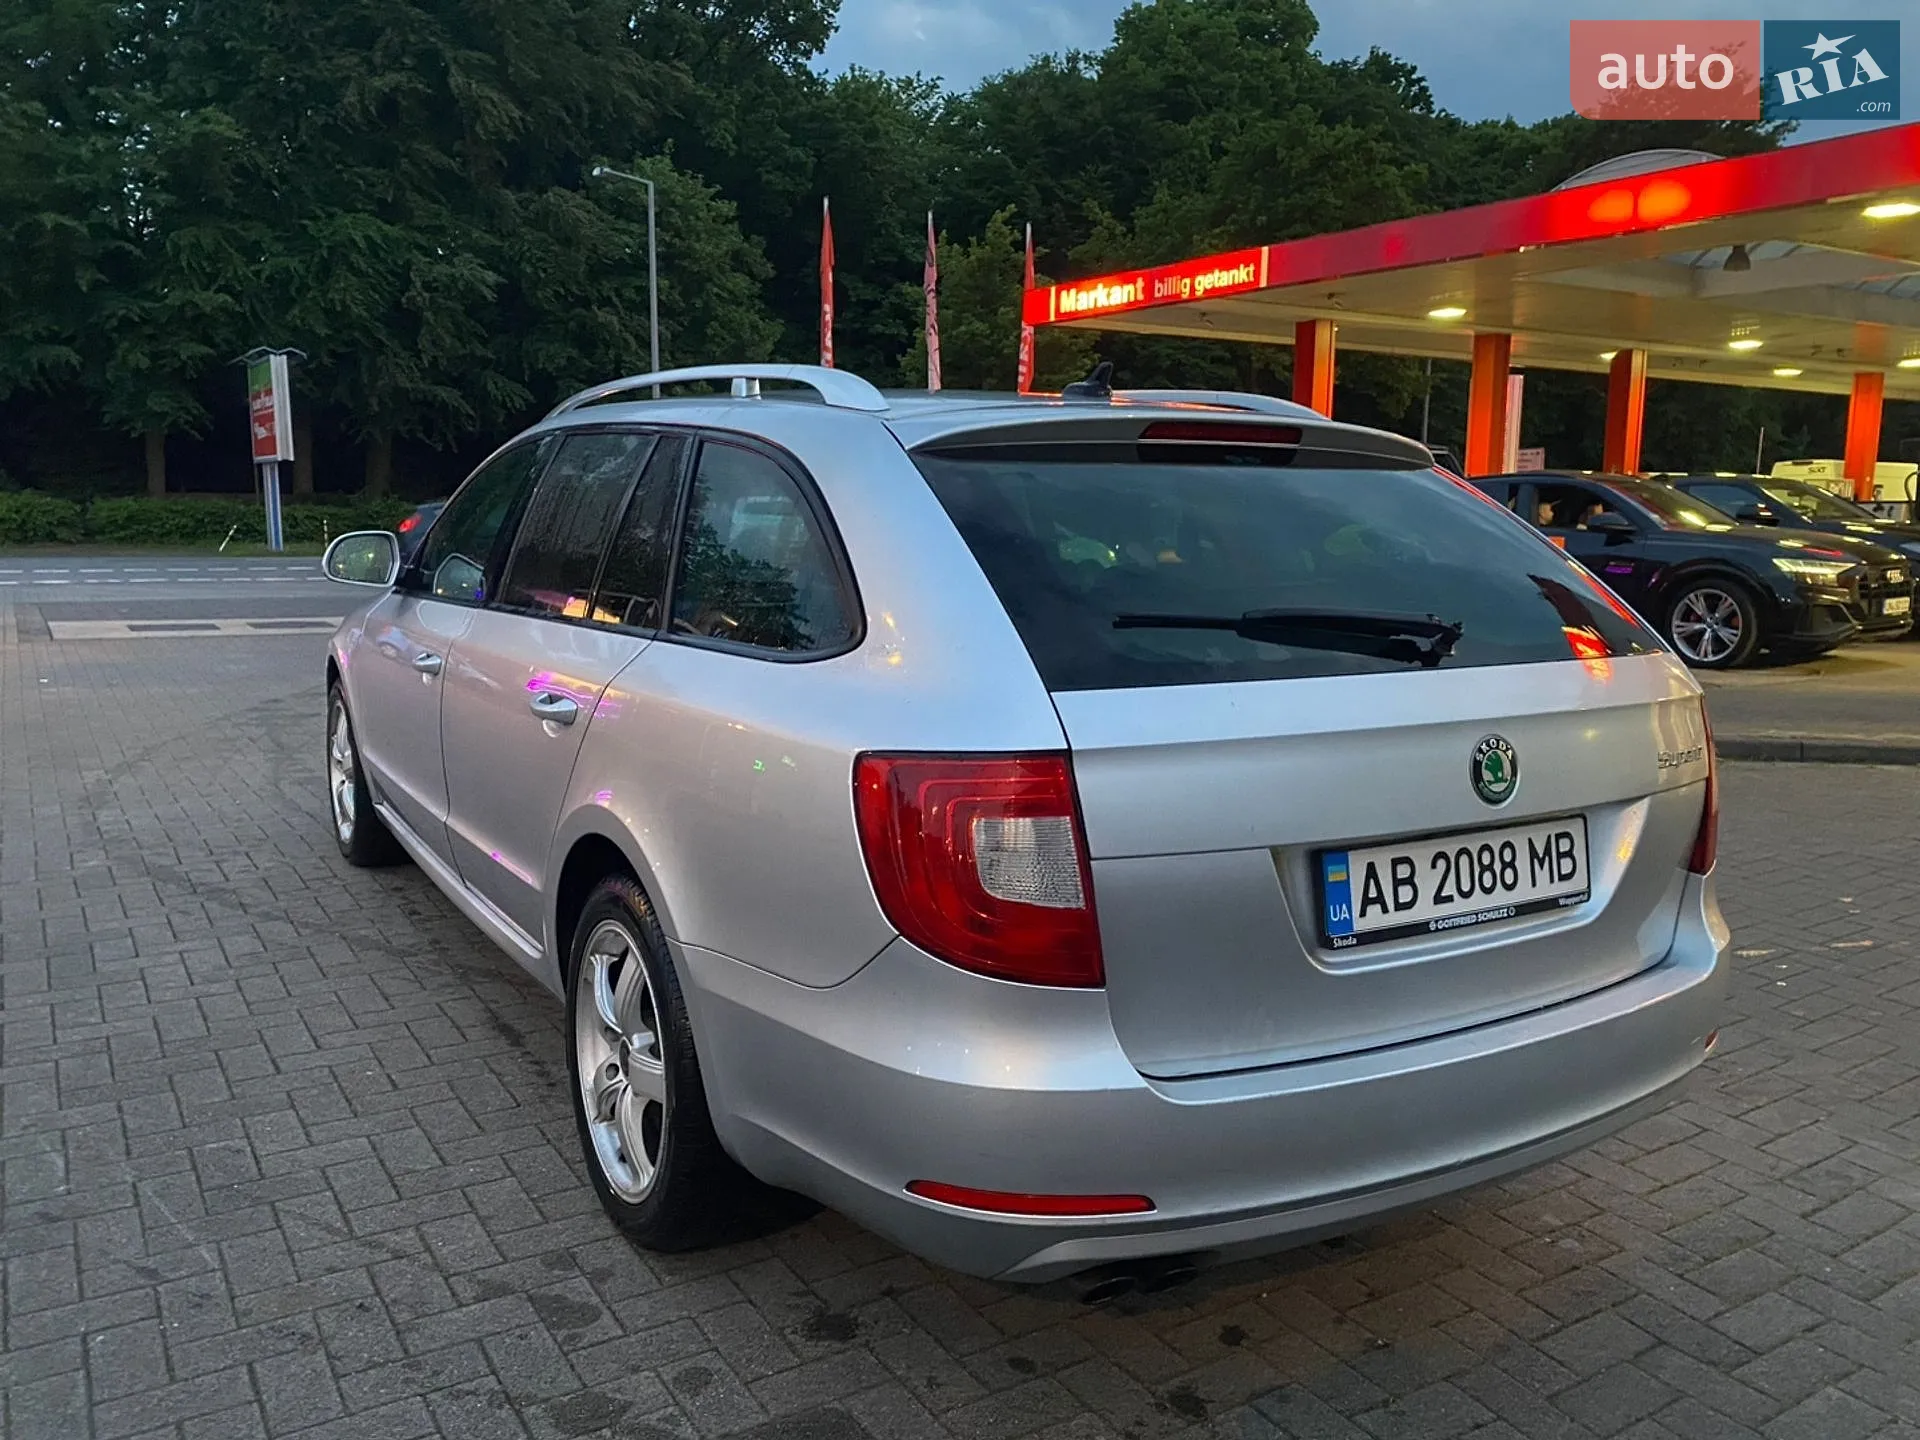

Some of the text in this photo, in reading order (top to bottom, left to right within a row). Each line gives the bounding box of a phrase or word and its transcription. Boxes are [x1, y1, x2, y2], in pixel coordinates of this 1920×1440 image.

[1059, 263, 1255, 314] Markant billig getankt
[1358, 831, 1577, 918] AB 2088 MB
[1329, 903, 1350, 922] UA
